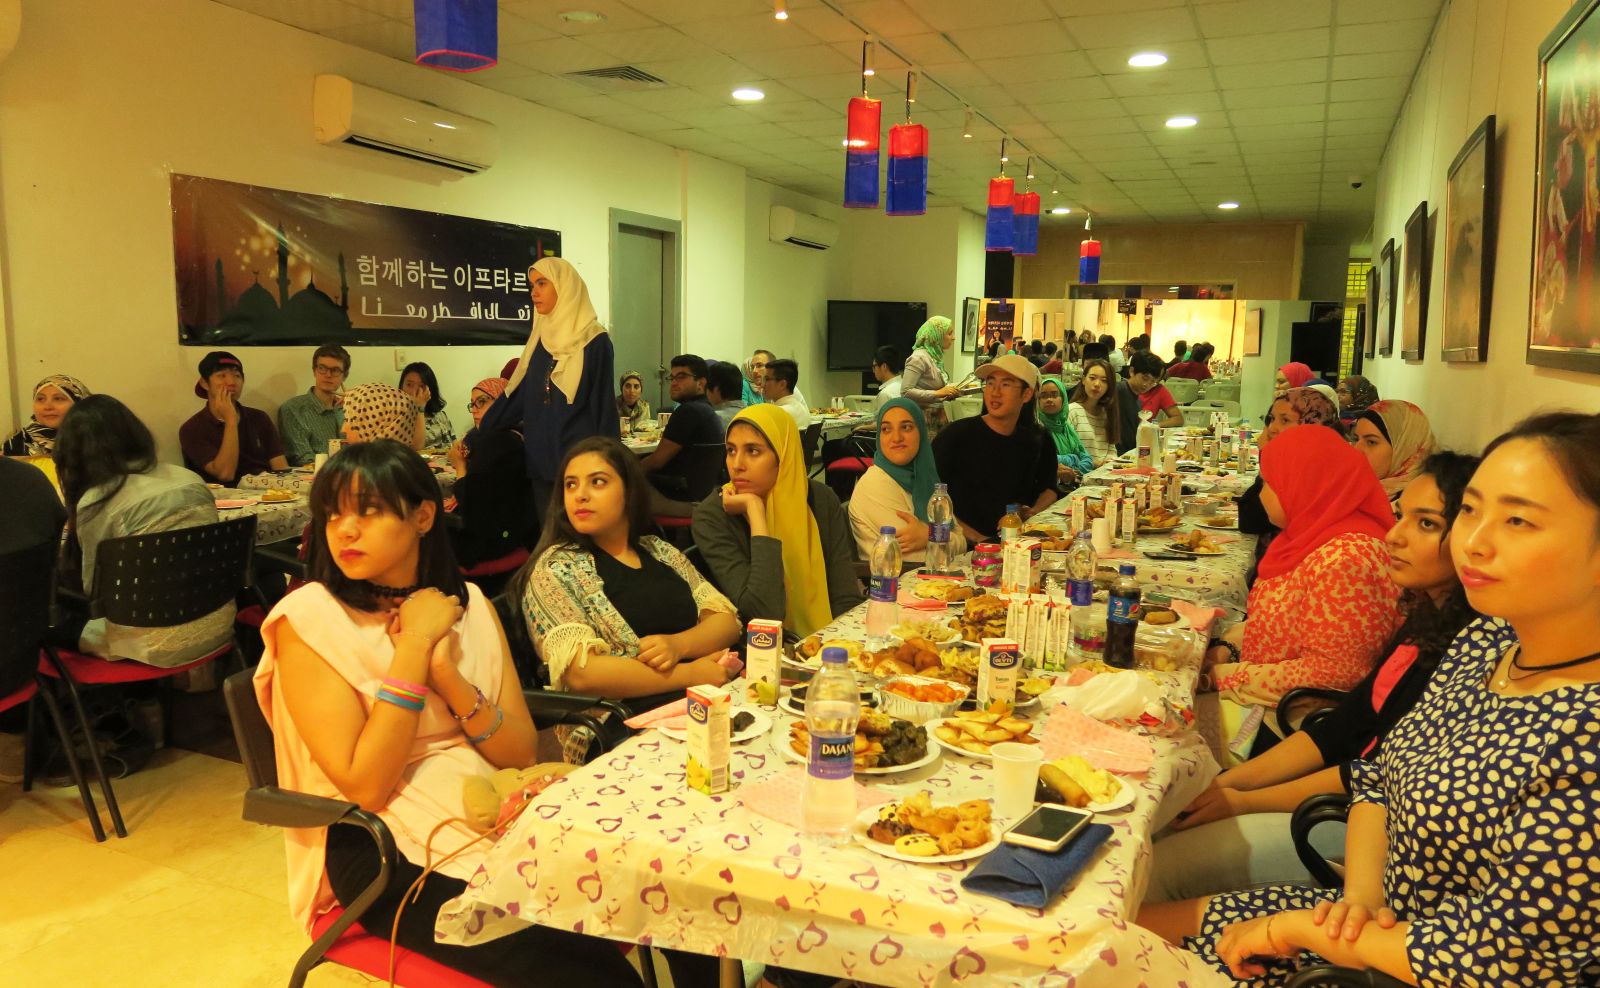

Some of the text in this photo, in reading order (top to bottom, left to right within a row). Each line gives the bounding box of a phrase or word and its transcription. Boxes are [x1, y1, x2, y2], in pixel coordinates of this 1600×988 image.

[356, 255, 530, 294] 함께하는 이프타르
[822, 742, 854, 756] DASAN
